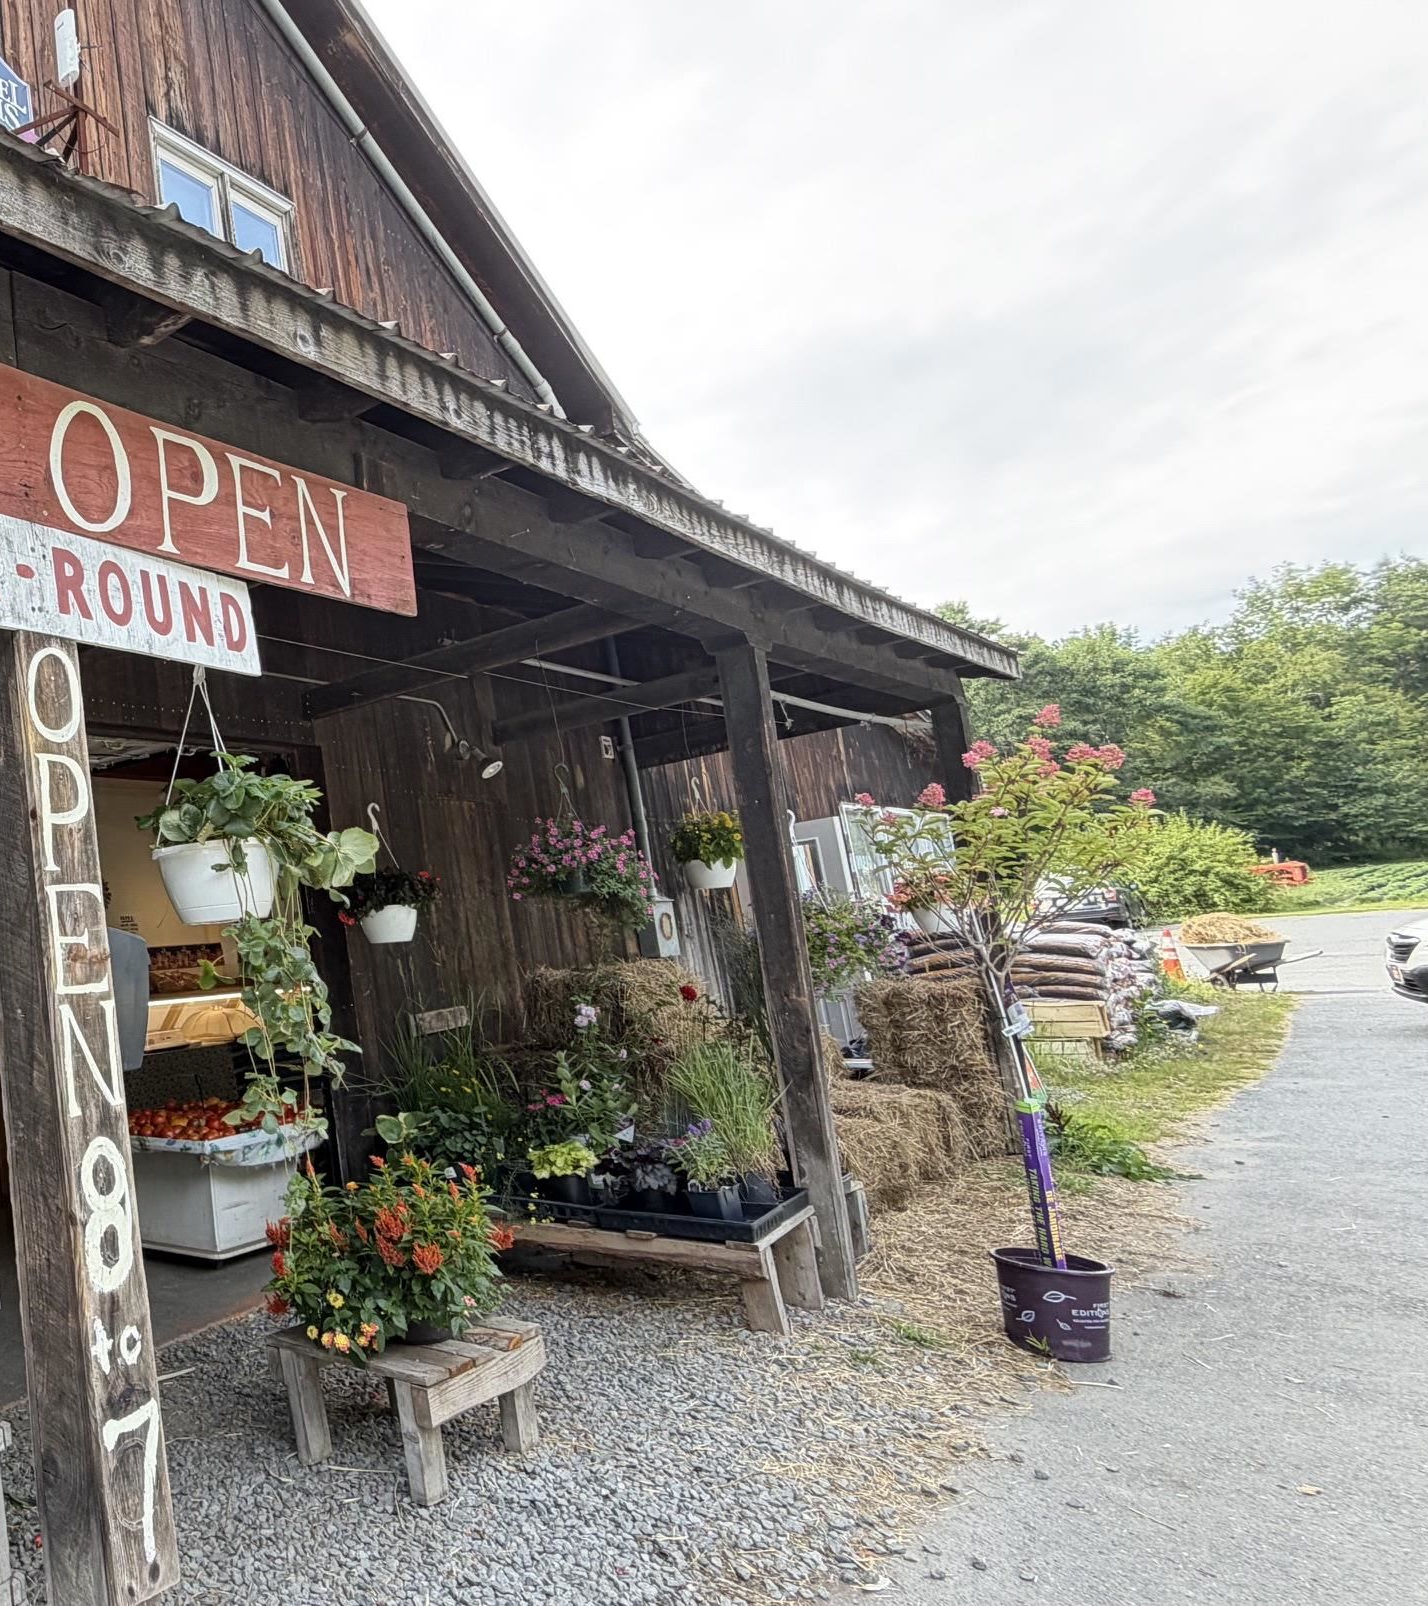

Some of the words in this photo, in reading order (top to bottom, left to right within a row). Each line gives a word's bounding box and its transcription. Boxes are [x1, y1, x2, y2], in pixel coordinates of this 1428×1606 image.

[49, 401, 349, 597] OPEN
[27, 646, 124, 1117] OPEN
[80, 1136, 133, 1293] 8
[1035, 1206, 1045, 1225] THE
[103, 1397, 159, 1563] 7
